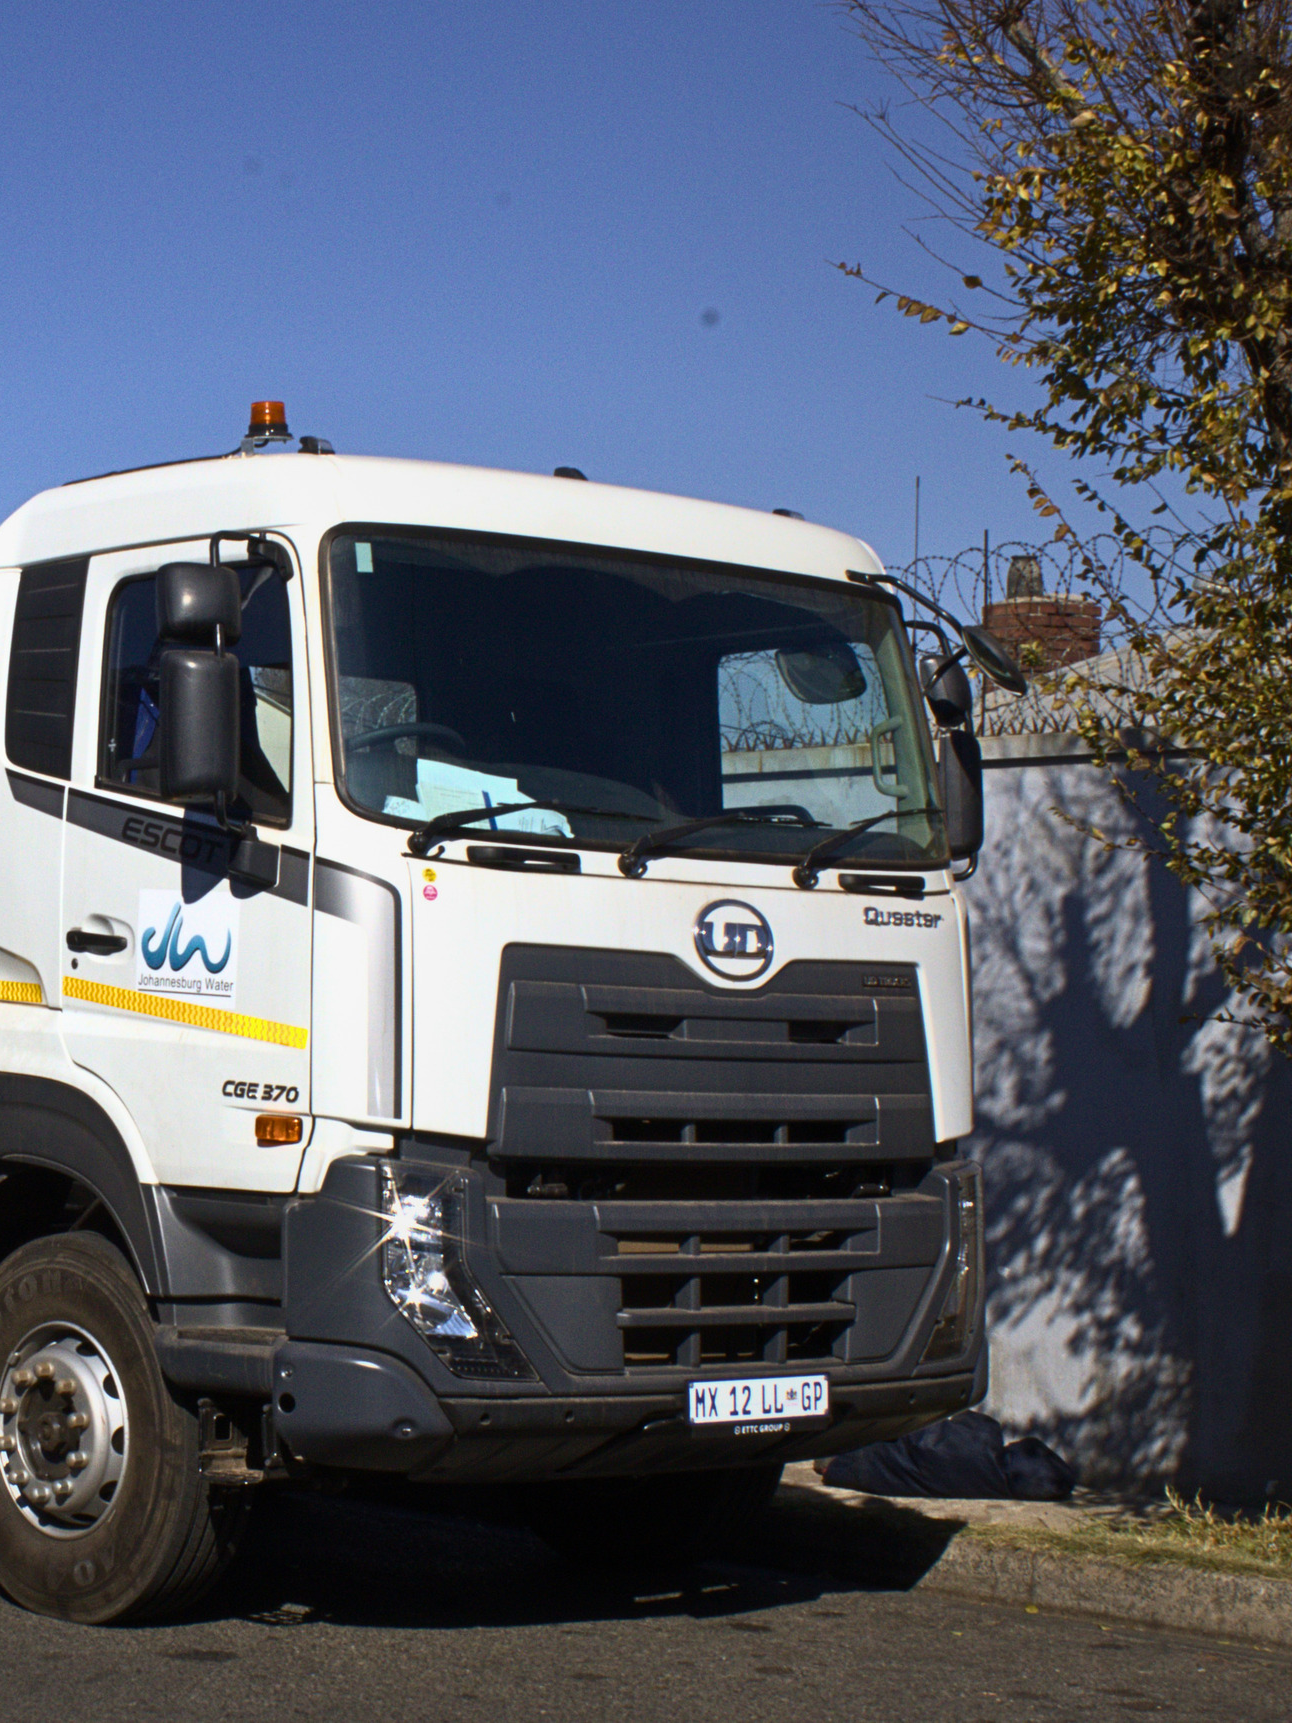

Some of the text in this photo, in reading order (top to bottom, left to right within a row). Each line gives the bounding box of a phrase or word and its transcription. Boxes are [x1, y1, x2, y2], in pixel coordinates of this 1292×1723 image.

[863, 906, 942, 929] Quester
[138, 974, 234, 993] Johannesburg Water
[222, 1080, 300, 1104] CGE 370
[695, 1381, 823, 1418] MX 12 LL GP
[741, 1423, 784, 1434] ETTC GROUP
